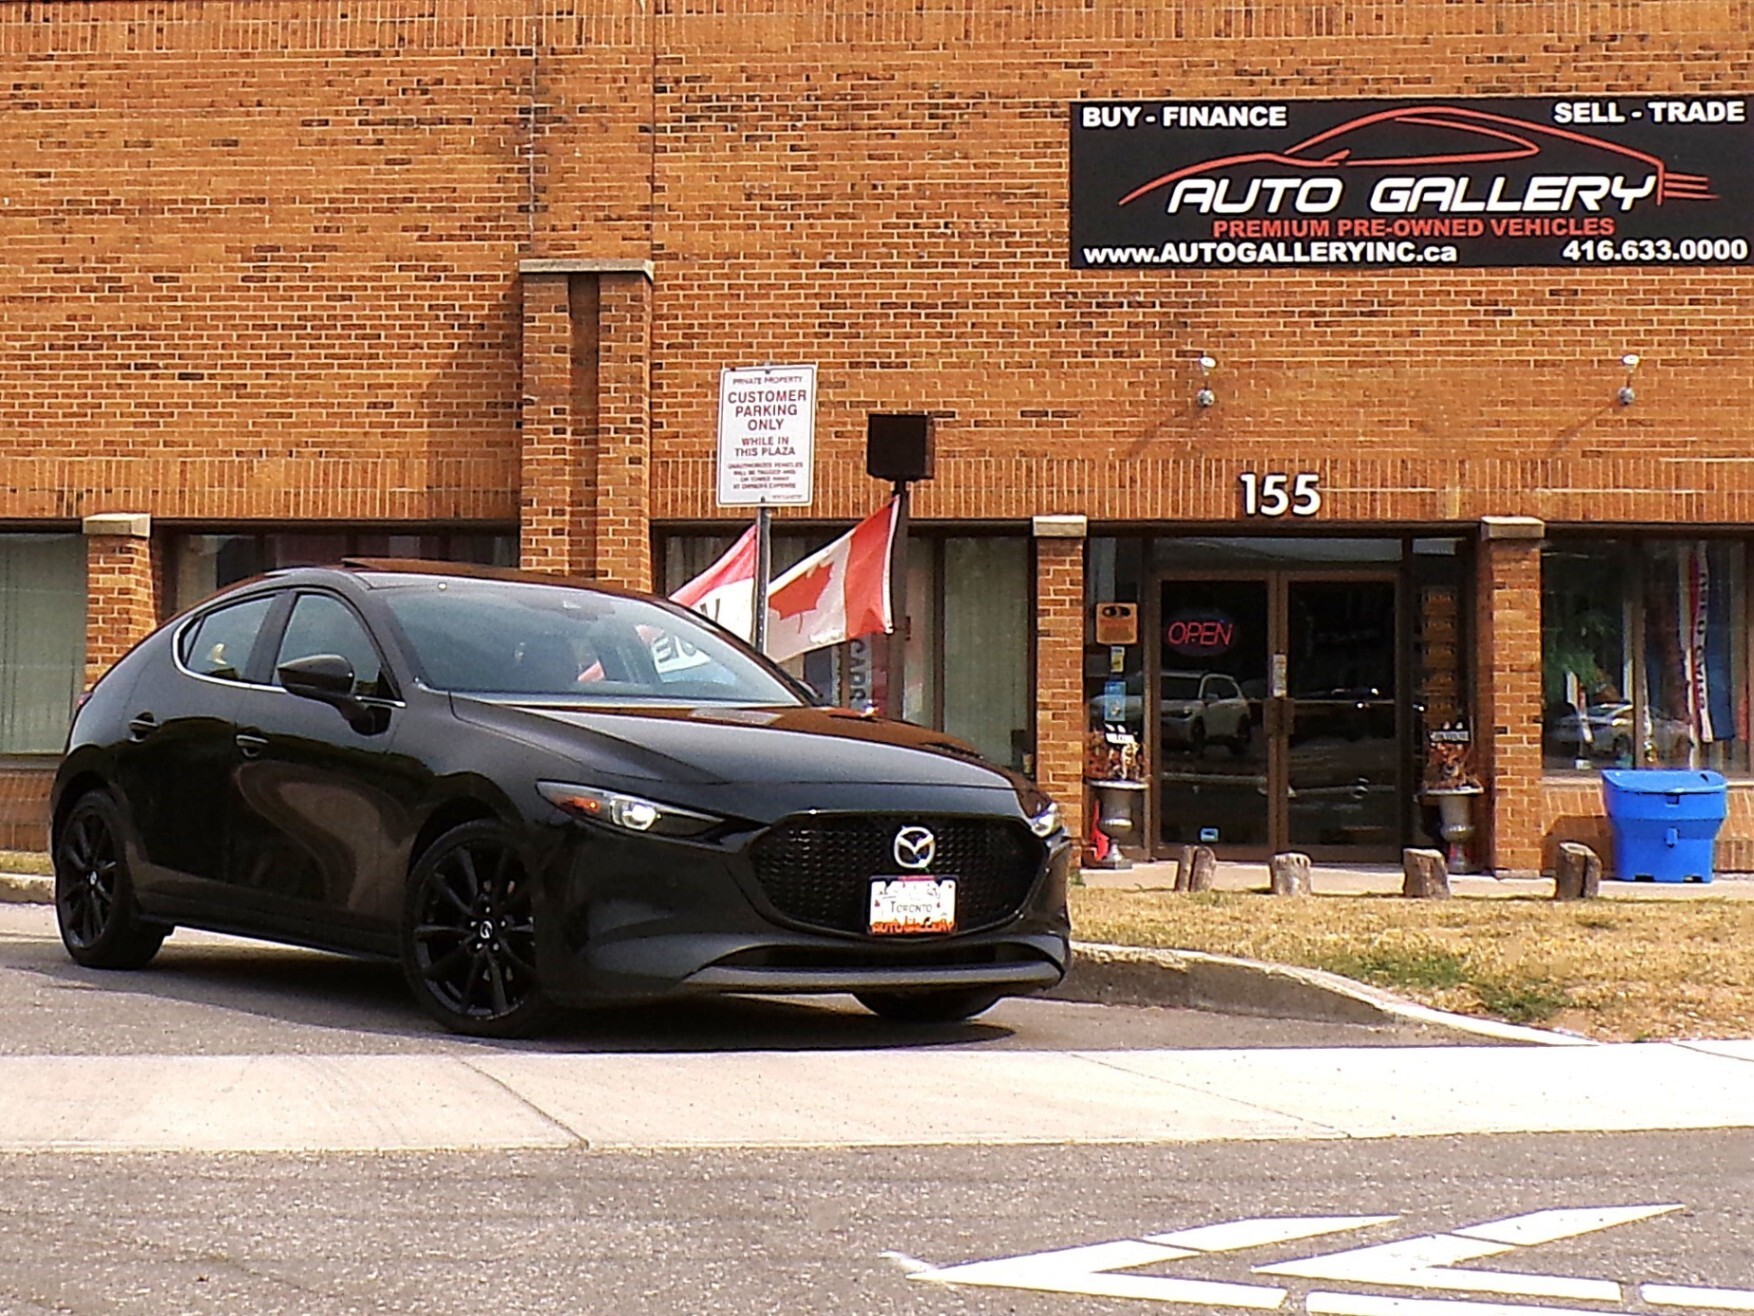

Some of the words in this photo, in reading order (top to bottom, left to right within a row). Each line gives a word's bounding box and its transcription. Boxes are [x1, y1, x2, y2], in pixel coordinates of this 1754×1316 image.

[1082, 106, 1142, 127] BUY
[1162, 105, 1288, 127] FINANCE
[1554, 102, 1626, 123] SELL
[1648, 101, 1745, 122] TRADE
[1166, 177, 1344, 214] AUTO
[1370, 175, 1656, 213] GALLERY
[1212, 219, 1331, 238] PREMIUM
[1337, 218, 1485, 238] PRE-OWNED
[1490, 217, 1616, 237] VEHICLES
[1083, 241, 1457, 264] www.AUTOGALLERYINC.ca
[1562, 239, 1749, 261] 416.633.0000
[728, 389, 807, 404] CUSTOMER
[735, 404, 797, 417] PARKING
[747, 418, 784, 431] ONLY
[734, 448, 758, 457] THIS
[761, 447, 795, 455] PLAZA
[741, 437, 774, 446] WHILE
[777, 436, 789, 445] IN
[1240, 474, 1321, 515] 155
[1168, 621, 1234, 645] OPEN
